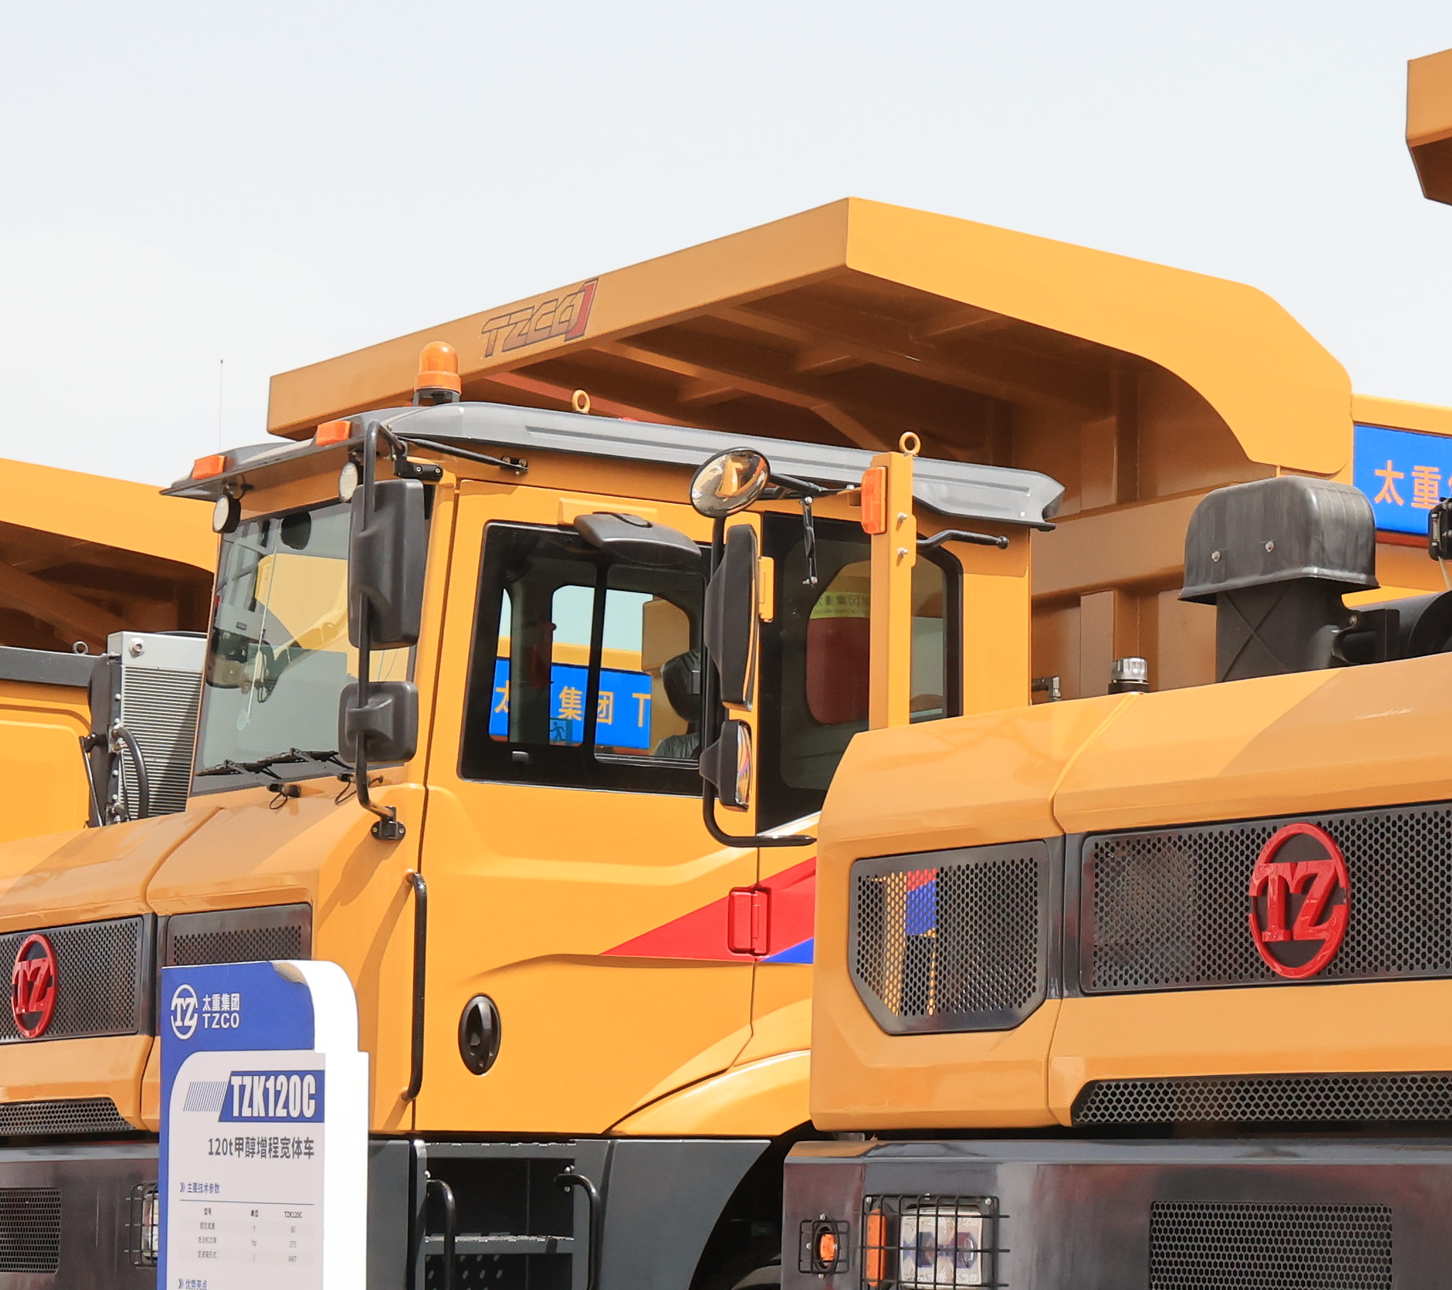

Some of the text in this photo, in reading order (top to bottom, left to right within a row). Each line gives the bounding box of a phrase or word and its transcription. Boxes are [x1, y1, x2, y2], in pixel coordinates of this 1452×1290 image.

[494, 680, 614, 725] 太集团
[202, 993, 240, 1012] 太重集团
[202, 1012, 240, 1029] TZCO
[231, 1074, 316, 1118] TZK120C
[207, 1137, 315, 1159] 120t甲醇增程宽体车
